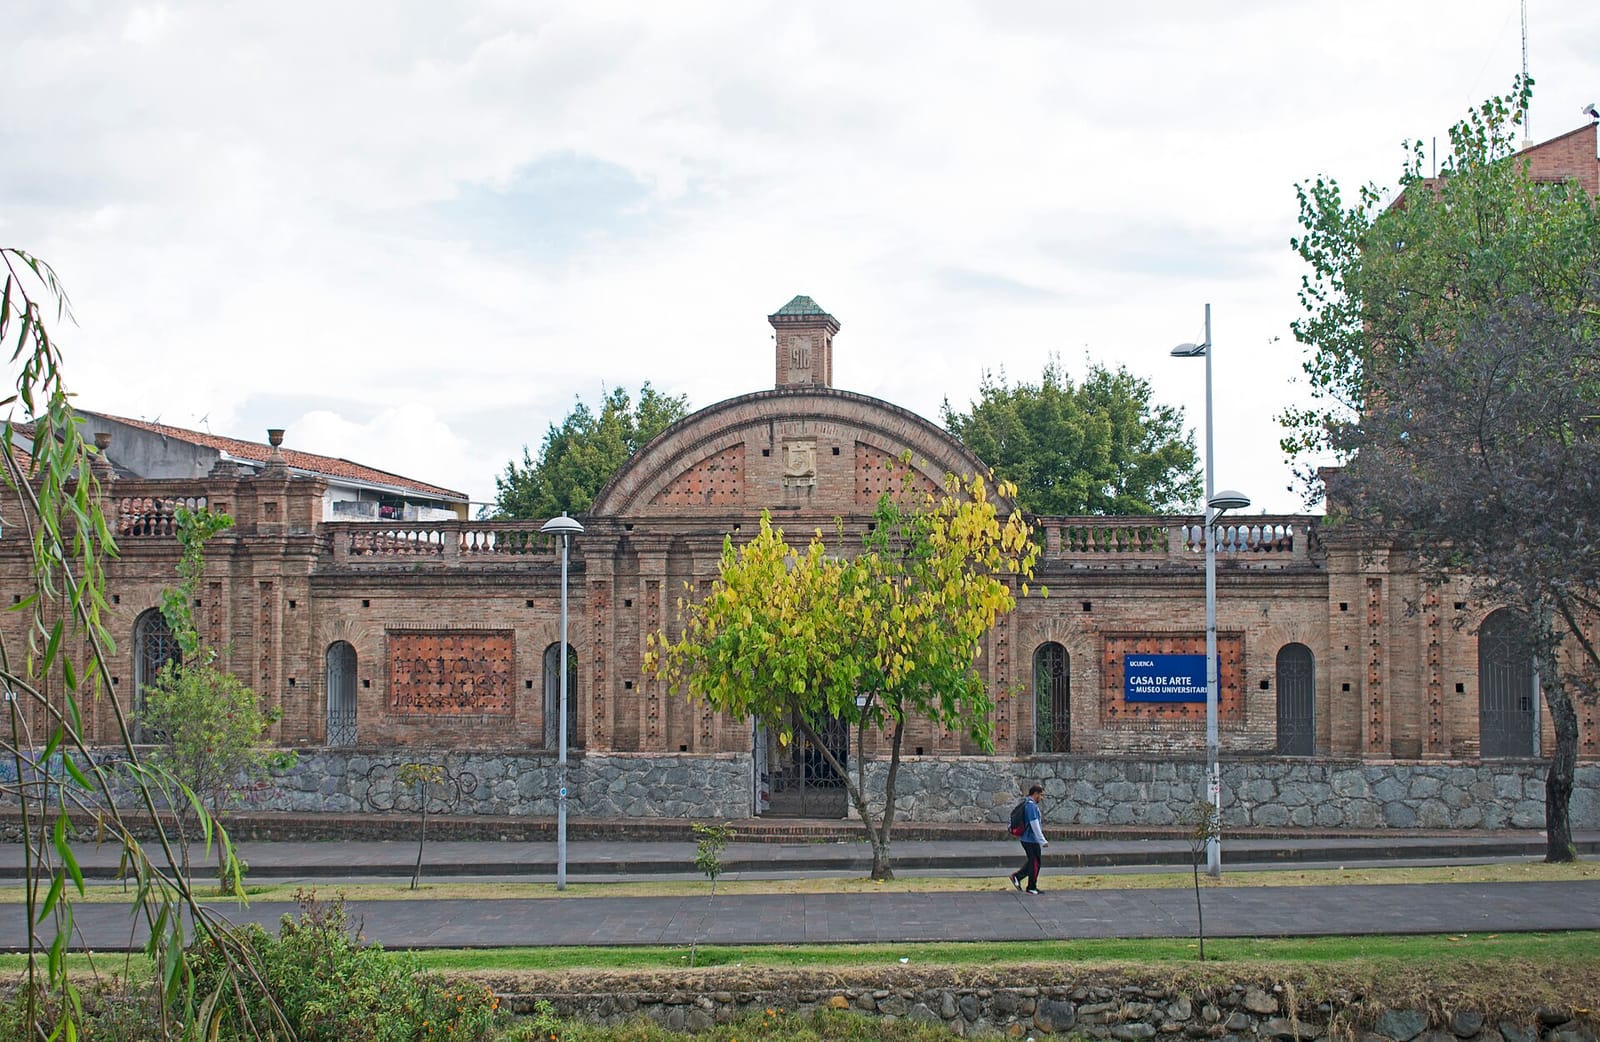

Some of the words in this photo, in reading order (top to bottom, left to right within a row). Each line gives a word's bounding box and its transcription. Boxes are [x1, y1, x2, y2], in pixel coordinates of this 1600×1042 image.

[1130, 676, 1154, 686] CASA
[1156, 676, 1167, 686] DE
[1169, 676, 1192, 686] ARTE
